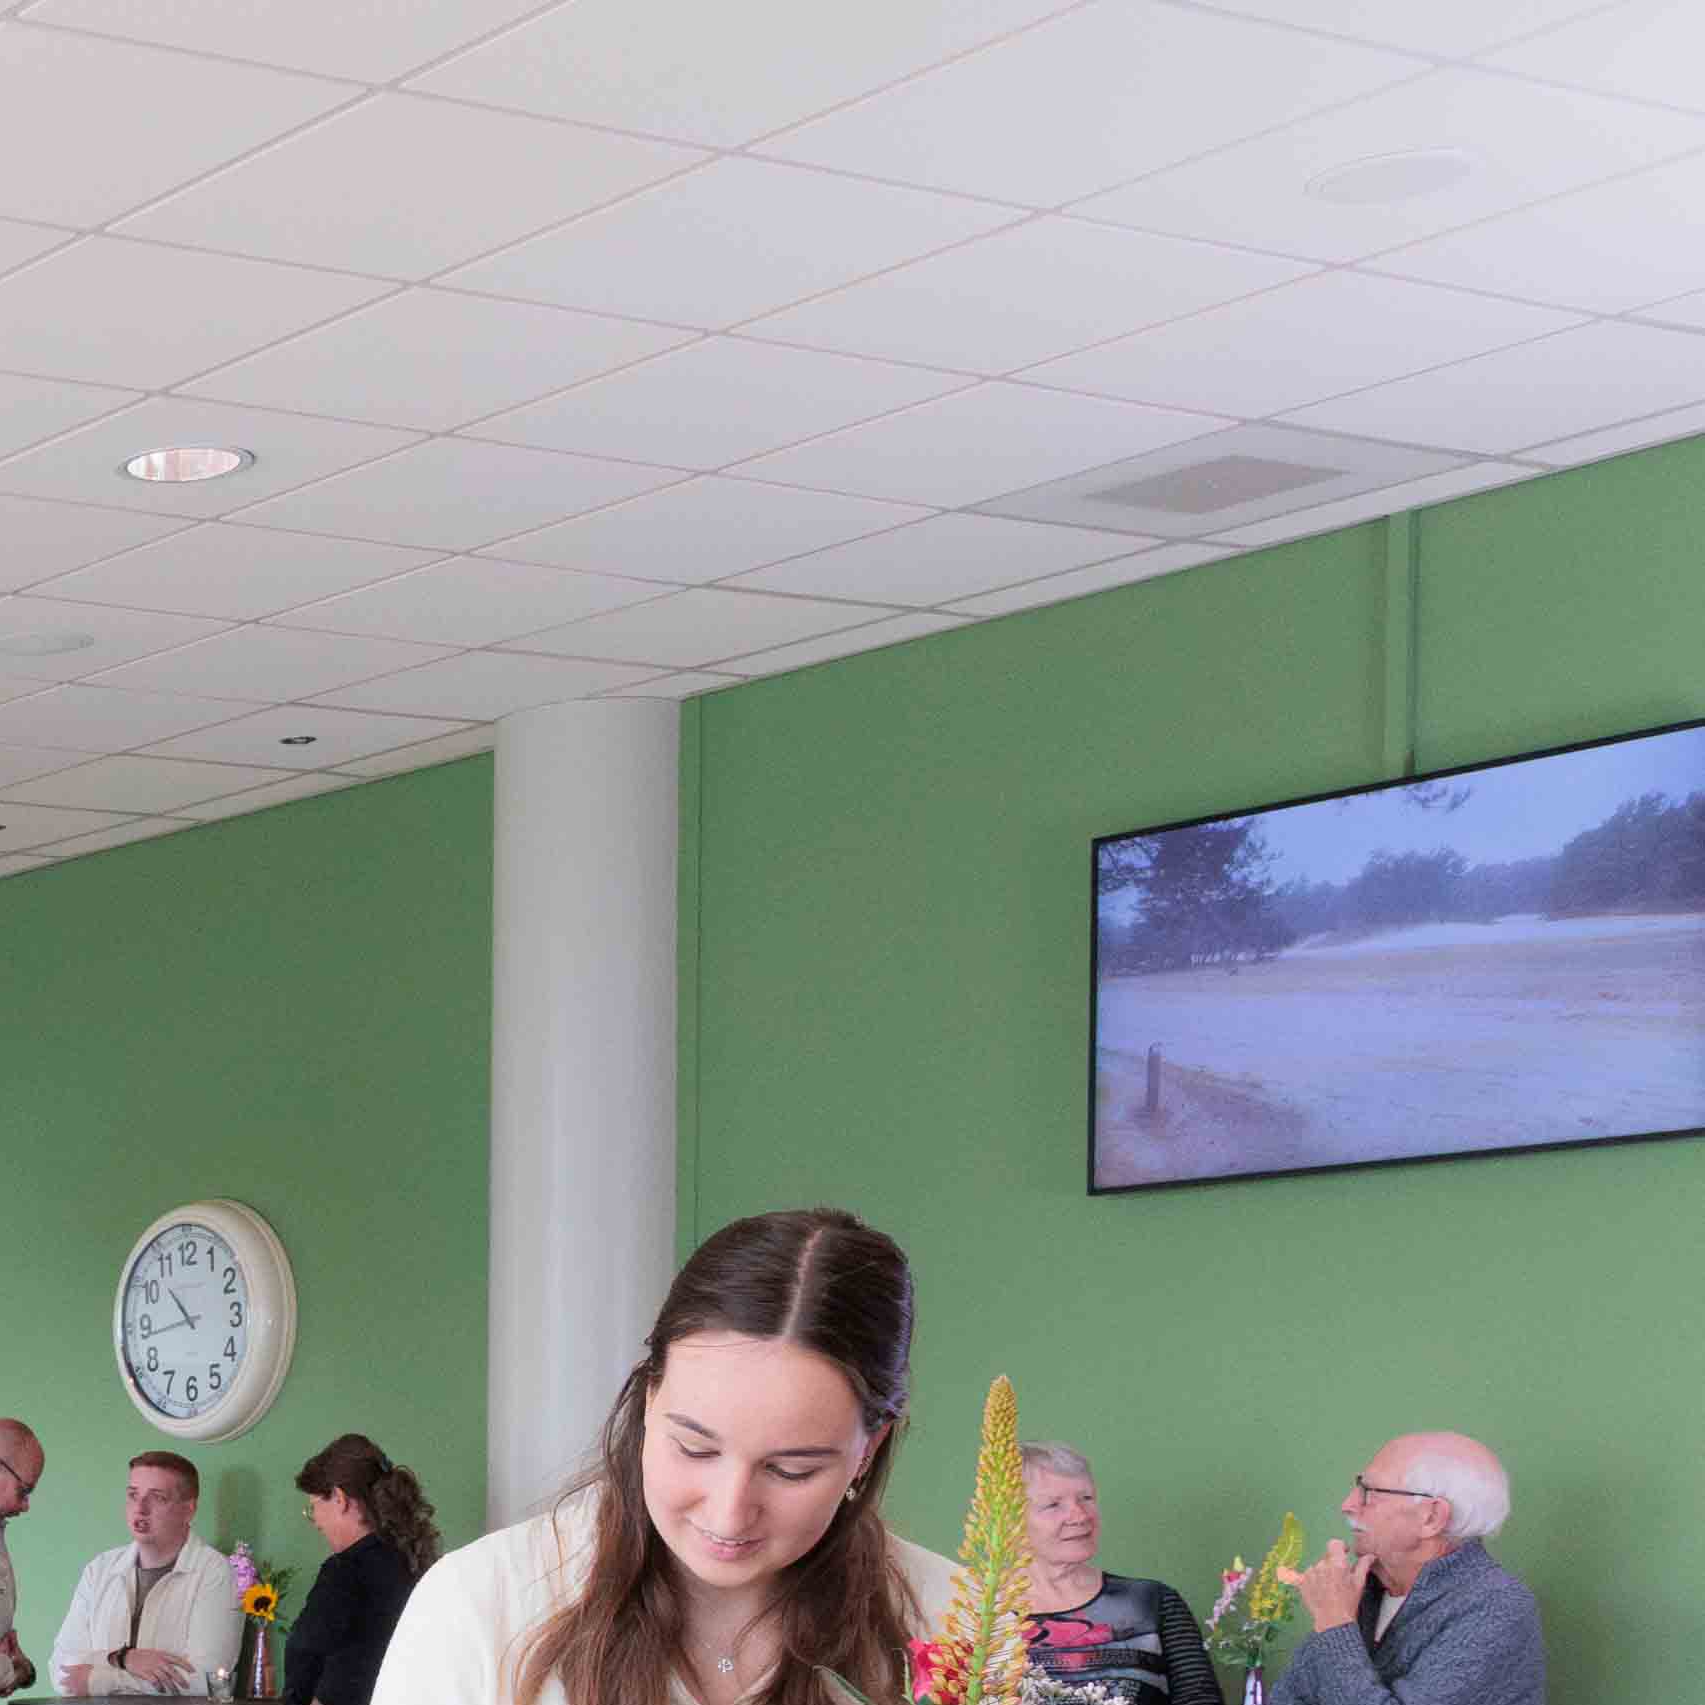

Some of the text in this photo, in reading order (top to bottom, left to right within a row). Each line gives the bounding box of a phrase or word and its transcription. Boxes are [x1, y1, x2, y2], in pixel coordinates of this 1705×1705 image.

[158, 1252, 173, 1278] 11
[177, 1240, 197, 1267] 12
[206, 1246, 215, 1272] 1
[142, 1279, 160, 1304] 10
[223, 1267, 236, 1294] 2
[140, 1313, 151, 1340] 9
[229, 1301, 242, 1328] 3
[146, 1346, 159, 1372] 8
[223, 1336, 237, 1362] 4
[162, 1370, 176, 1395] 7
[186, 1375, 198, 1402] 6
[209, 1363, 222, 1390] 5
